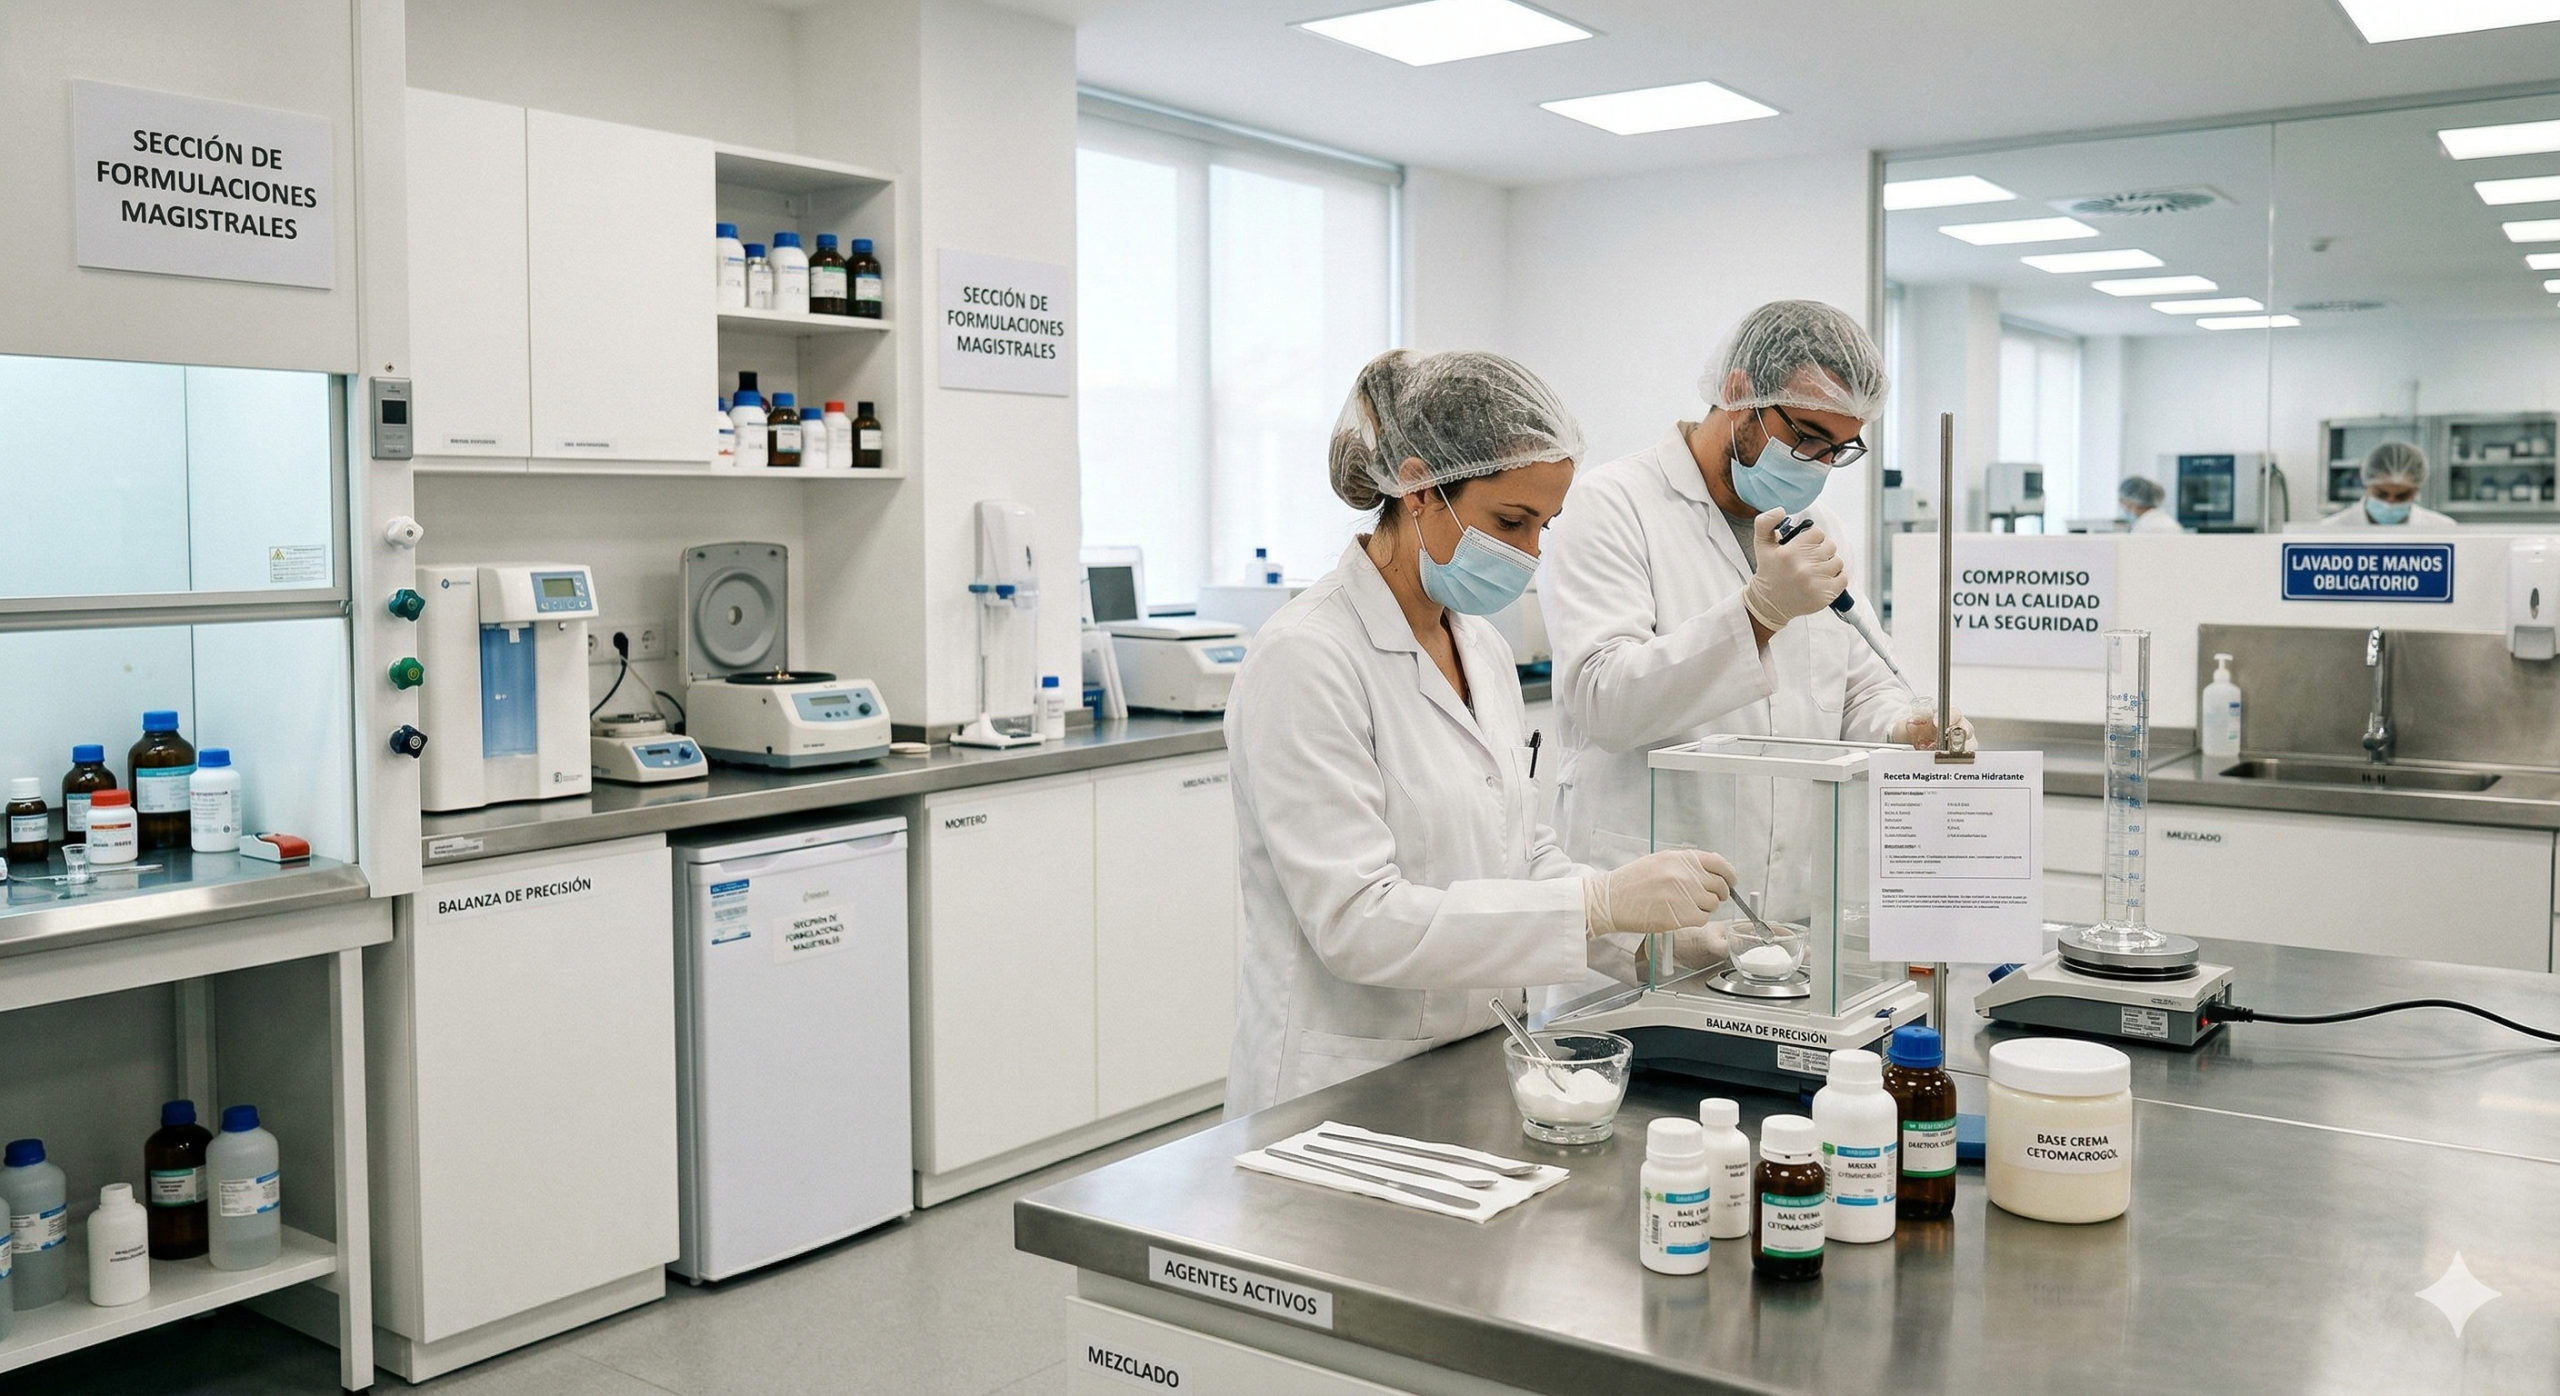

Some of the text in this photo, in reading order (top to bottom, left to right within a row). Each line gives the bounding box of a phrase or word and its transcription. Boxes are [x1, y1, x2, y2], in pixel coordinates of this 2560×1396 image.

[134, 130, 282, 170] SECCIÓN DE
[98, 161, 316, 208] FORMULACIONES
[122, 200, 297, 239] MAGISTRALES
[964, 286, 1047, 311] SECCIÓN DE
[948, 310, 1064, 336] FORMULACIONES
[958, 336, 1055, 359] MAGISTRALES
[2292, 555, 2443, 572] LAVADO DE MANOS
[1963, 570, 2089, 585] COMPROMISO
[2313, 574, 2419, 591] OBLIGATORIO
[1953, 593, 2099, 608] CON LA CALIDAD
[1954, 615, 2098, 632] Y LA SEGURIDAD
[1883, 772, 2025, 782] Receta Magistral: Crema Hidratante
[439, 877, 590, 914] BALANZA DE PRECISIÓN
[1706, 1018, 1827, 1044] BALANZA DE PRECISIÓN
[2038, 1134, 2109, 1147] BASE CREMA
[1165, 1261, 1316, 1314] AGENTES ACTIVOS
[1089, 1346, 1179, 1387] MEZCLADO
